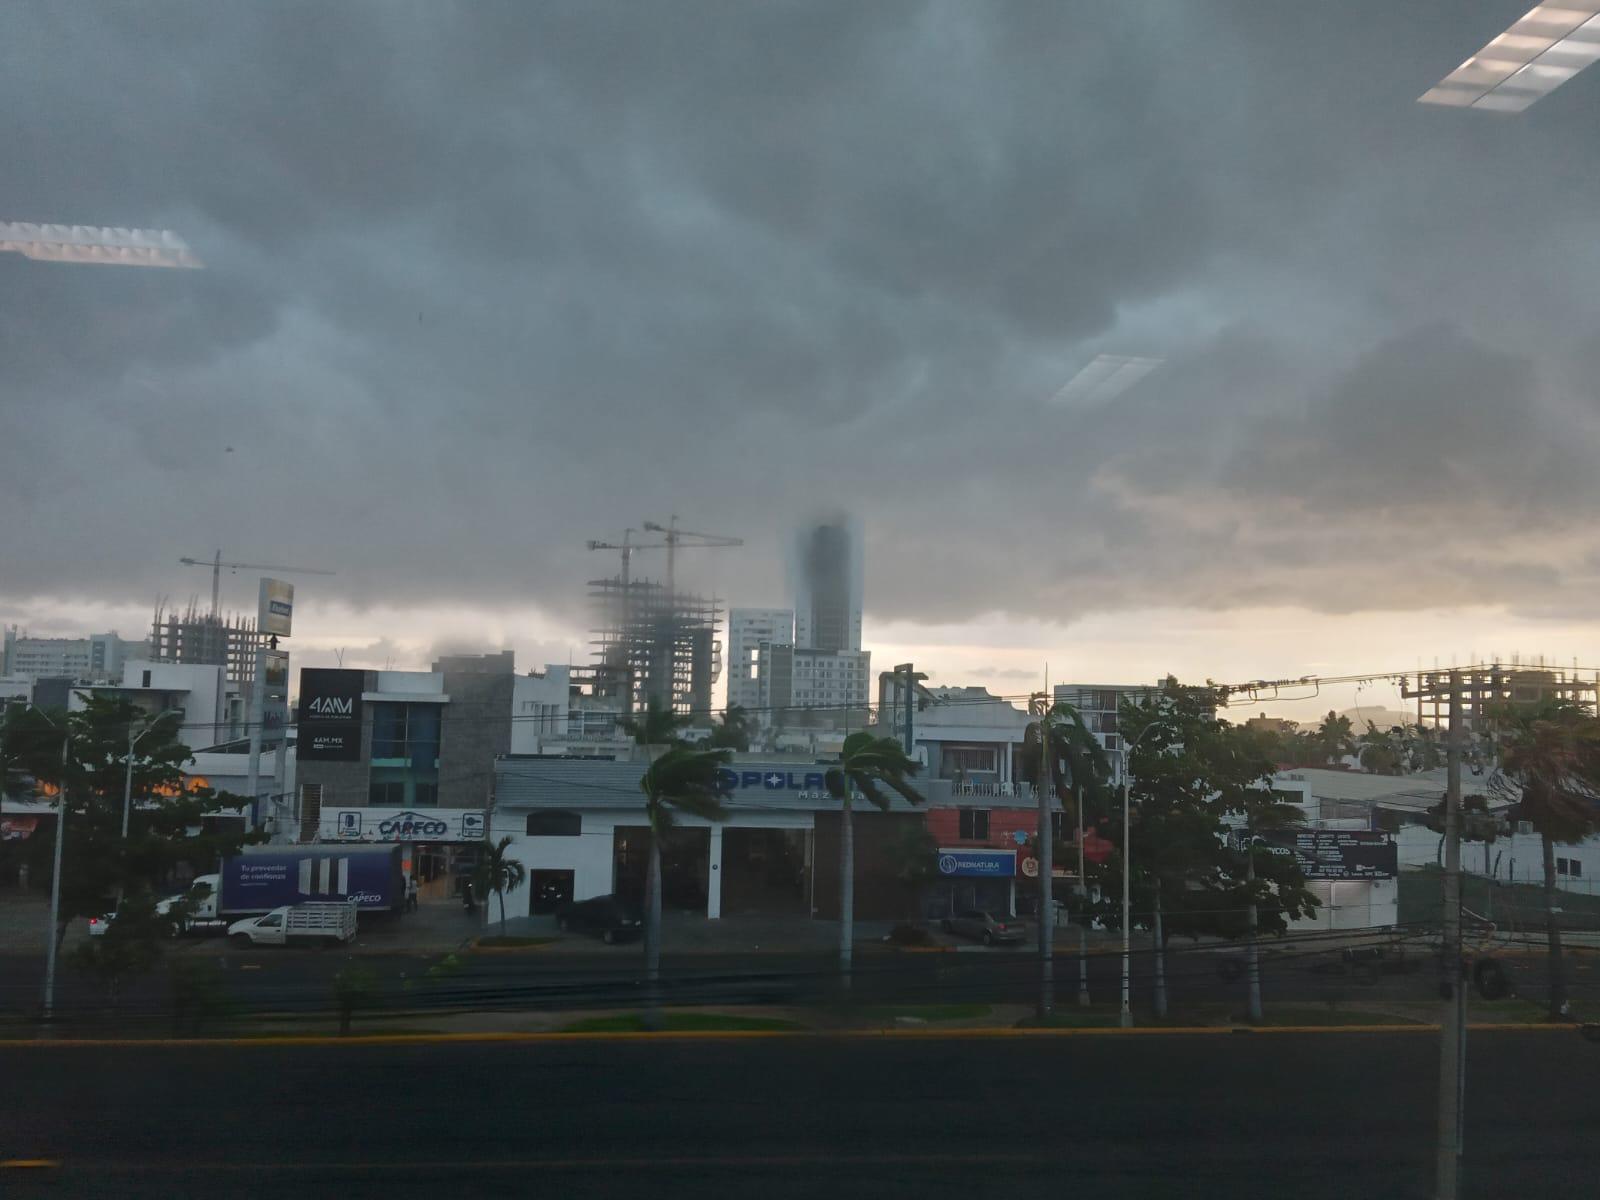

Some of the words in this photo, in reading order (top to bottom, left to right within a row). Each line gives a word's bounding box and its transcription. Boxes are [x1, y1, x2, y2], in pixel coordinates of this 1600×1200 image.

[308, 696, 353, 714] 4AM
[378, 821, 448, 835] CAPECO
[347, 894, 382, 903] CAPECO
